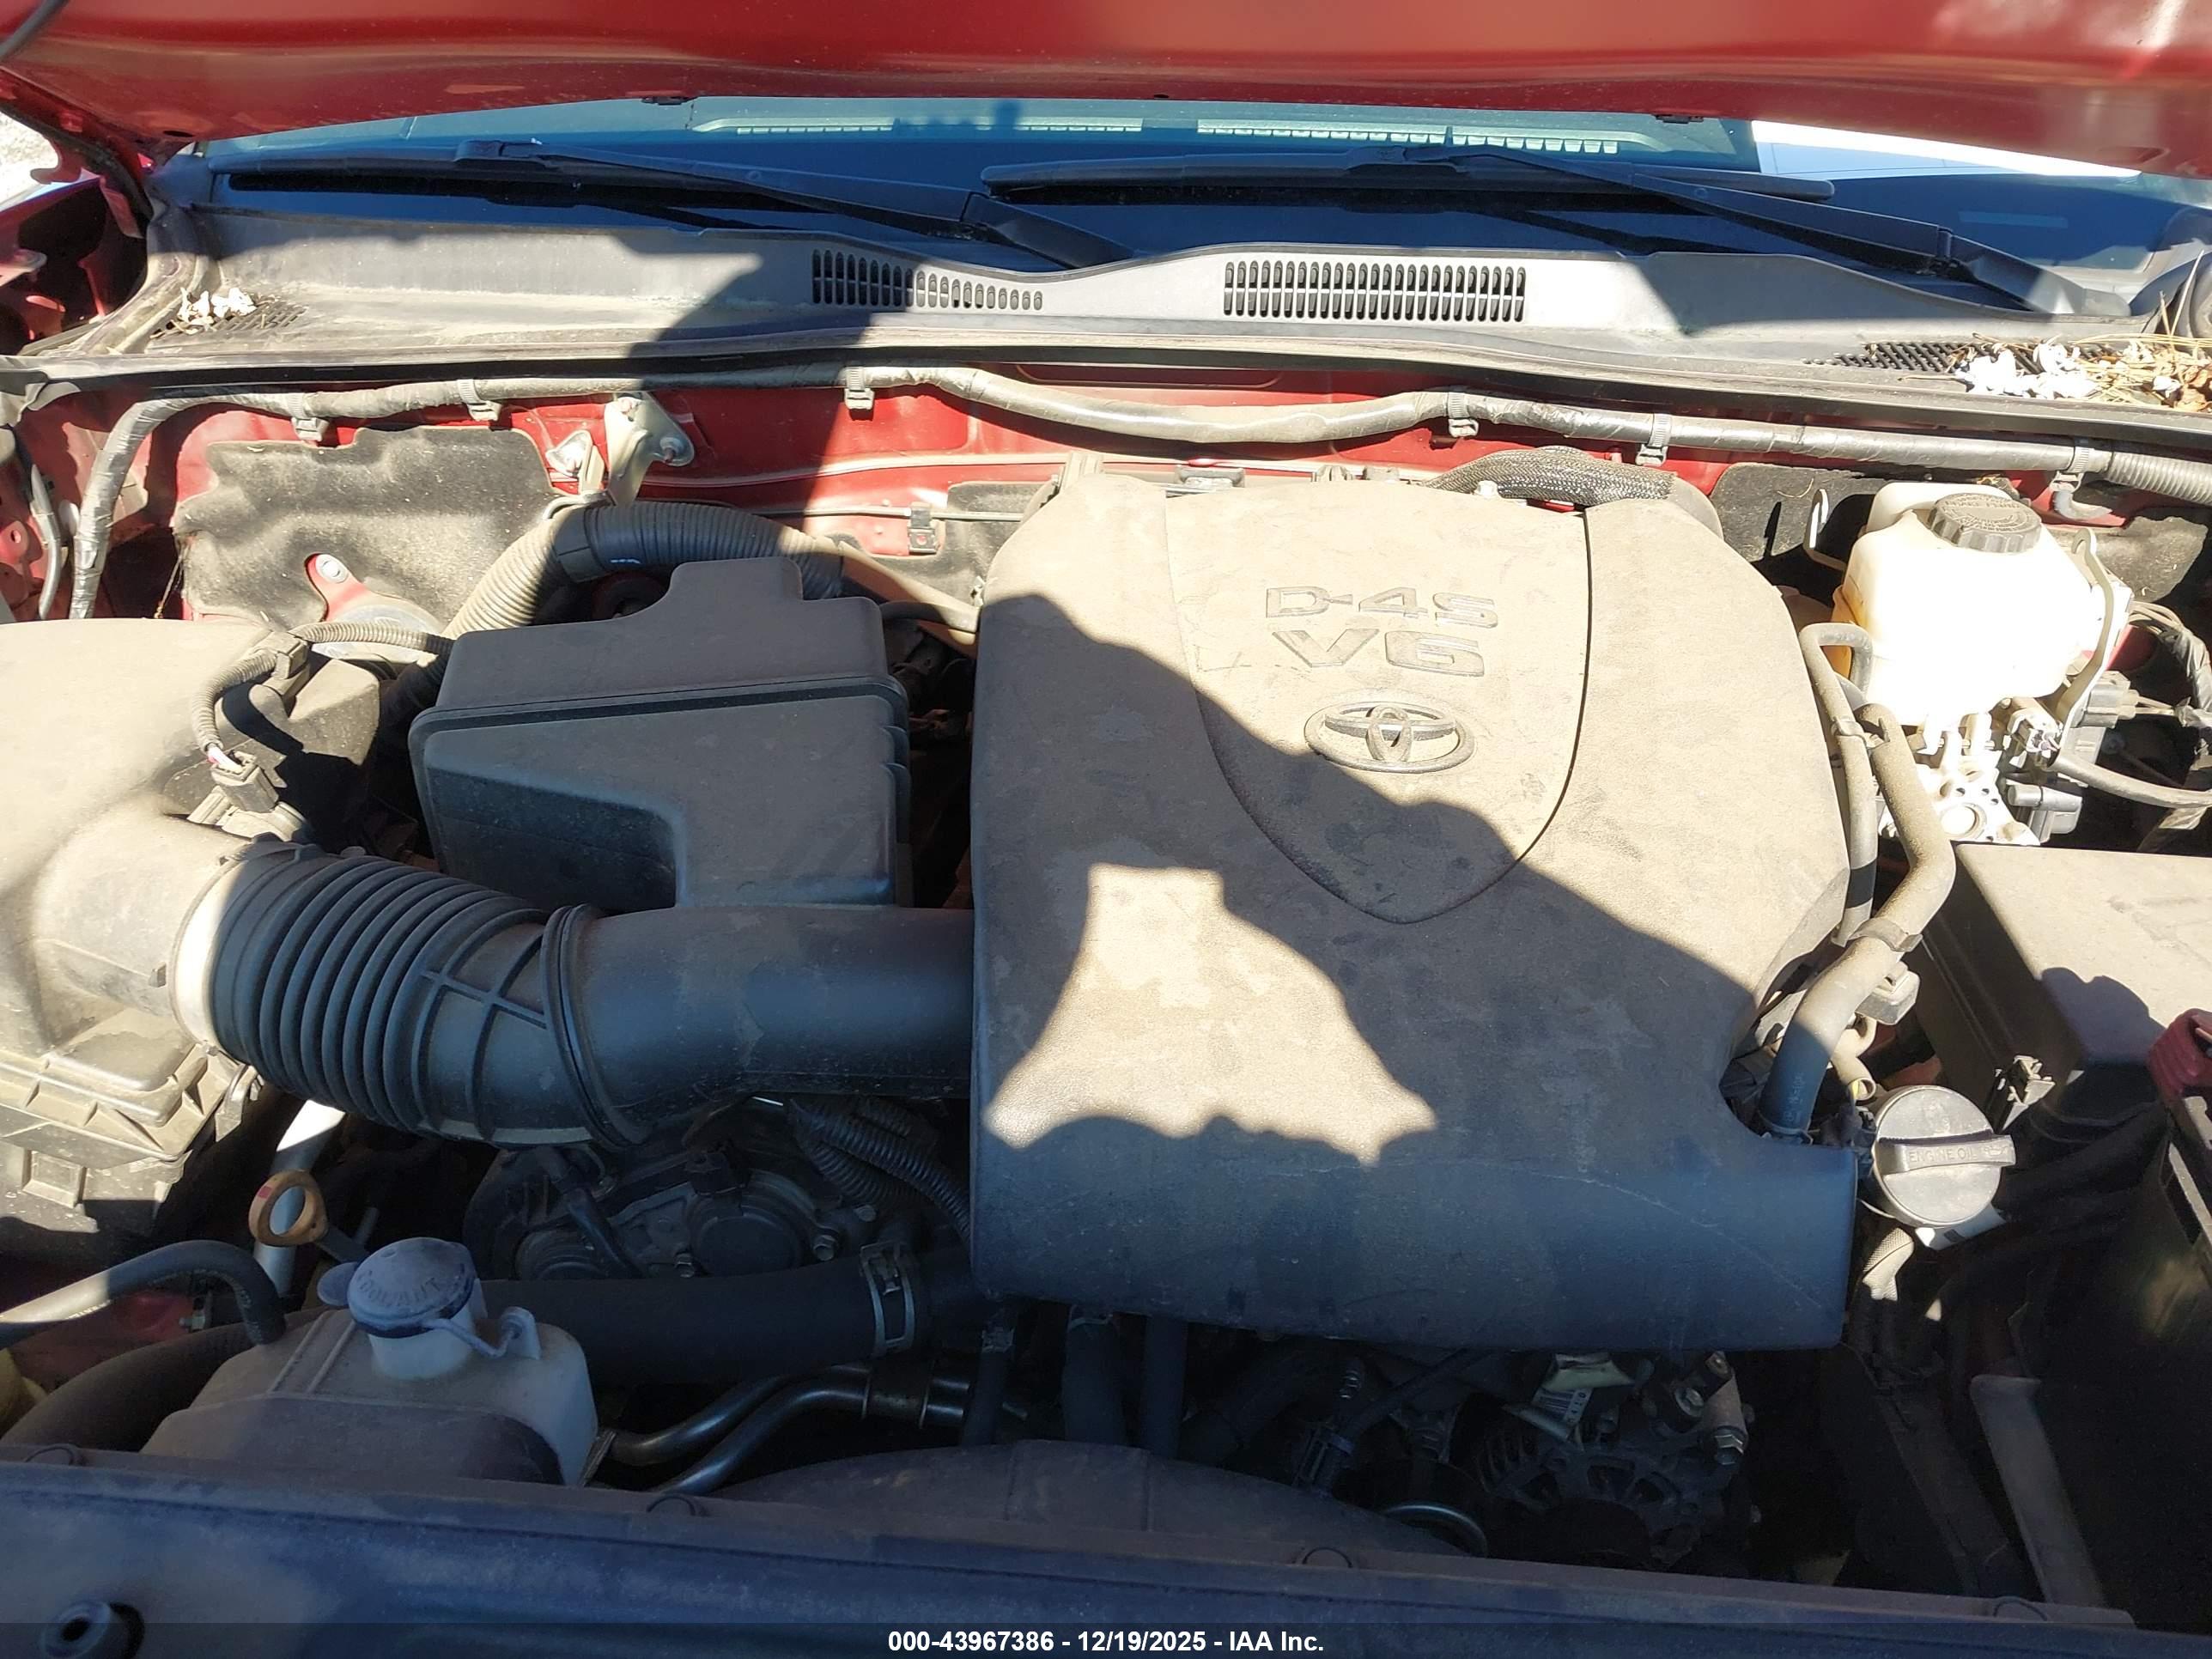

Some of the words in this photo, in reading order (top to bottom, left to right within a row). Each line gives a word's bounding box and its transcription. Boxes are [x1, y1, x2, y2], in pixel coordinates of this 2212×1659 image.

[1265, 586, 1498, 629] D-4S
[1272, 628, 1485, 677] V6
[1908, 1147, 1954, 1163] ENGINE
[1958, 1147, 1978, 1160] OIL
